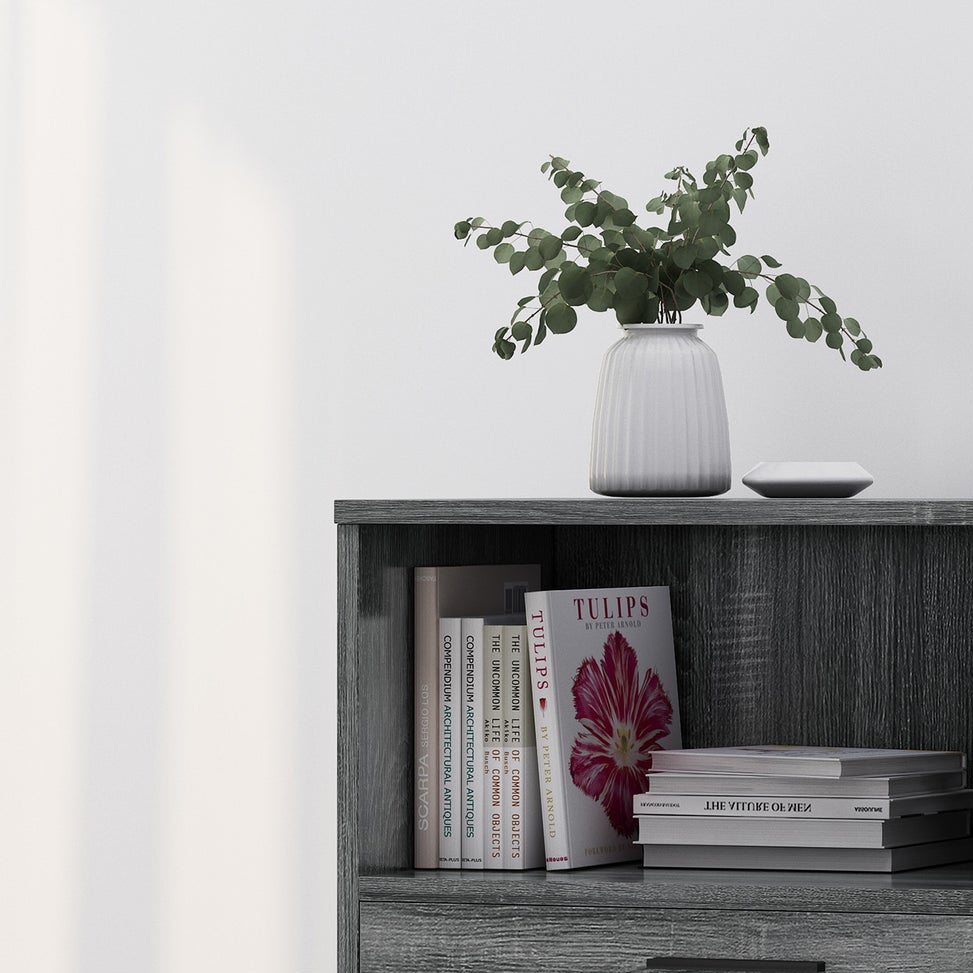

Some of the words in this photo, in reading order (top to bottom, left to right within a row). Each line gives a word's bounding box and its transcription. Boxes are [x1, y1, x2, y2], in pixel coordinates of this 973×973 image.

[573, 595, 649, 620] TULIPS
[585, 622, 593, 630] BY
[595, 621, 615, 629] PETER
[617, 620, 642, 628] ARNOLD
[491, 634, 500, 653] THE
[511, 634, 520, 653] THE
[531, 610, 549, 691] TULIPS
[443, 635, 452, 702] COMPENDIUM
[466, 635, 475, 702] COMPENDIUM
[491, 660, 500, 711] UNCOMMON
[511, 660, 520, 711] UNCOMMON
[420, 684, 429, 704] LOS
[420, 708, 429, 748] SERGIO
[443, 705, 452, 785] ARCHITECTURAL
[466, 705, 475, 785] ARCHITECTURAL
[491, 718, 500, 743] LIFE
[511, 718, 520, 743] LIFE
[540, 725, 549, 740] BY
[491, 749, 500, 761] OF
[511, 749, 520, 762] OF
[542, 745, 552, 784] PETER
[418, 754, 429, 832] SCARPA
[491, 769, 500, 807] COMMON
[511, 769, 520, 807] COMMON
[442, 787, 452, 838] ANTIQUES
[464, 787, 475, 838] ANTIQUES
[545, 788, 556, 838] ARNOLD
[491, 813, 500, 858] OBJECTS
[511, 813, 520, 859] OBJECTS
